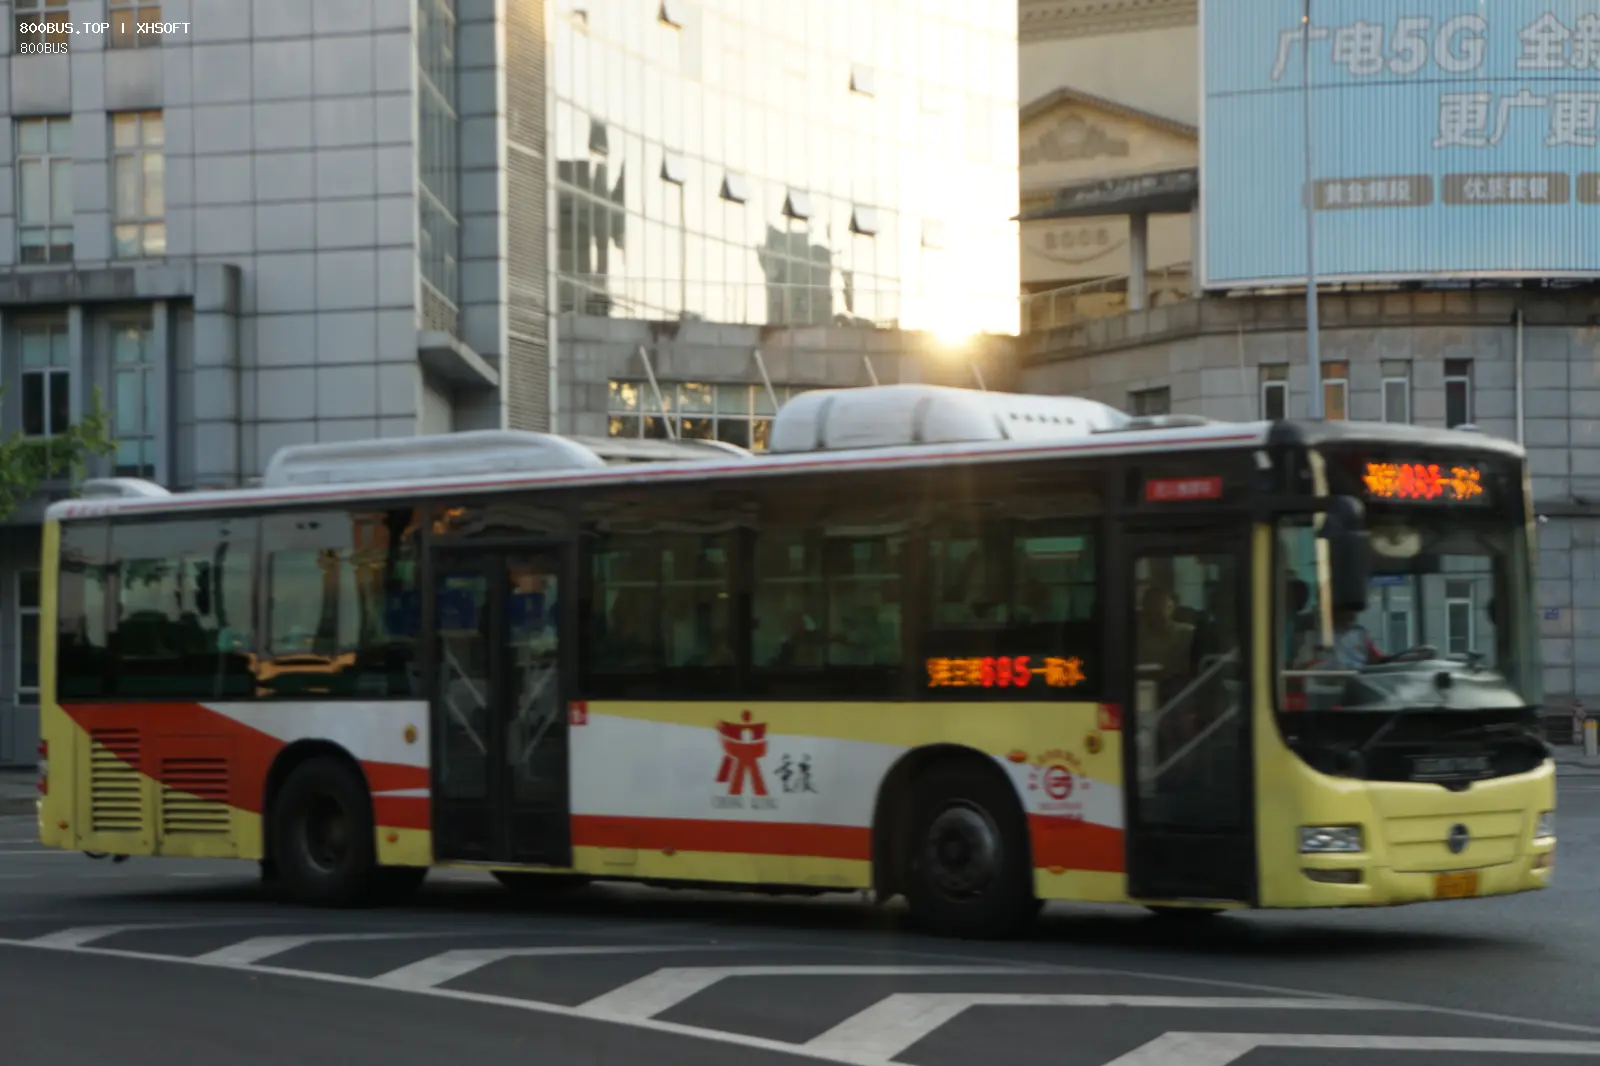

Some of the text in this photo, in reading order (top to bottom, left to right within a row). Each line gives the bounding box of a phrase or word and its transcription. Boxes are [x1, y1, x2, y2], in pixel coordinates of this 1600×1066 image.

[1270, 14, 1489, 81] 广电5G
[1432, 89, 1600, 149] 更广更
